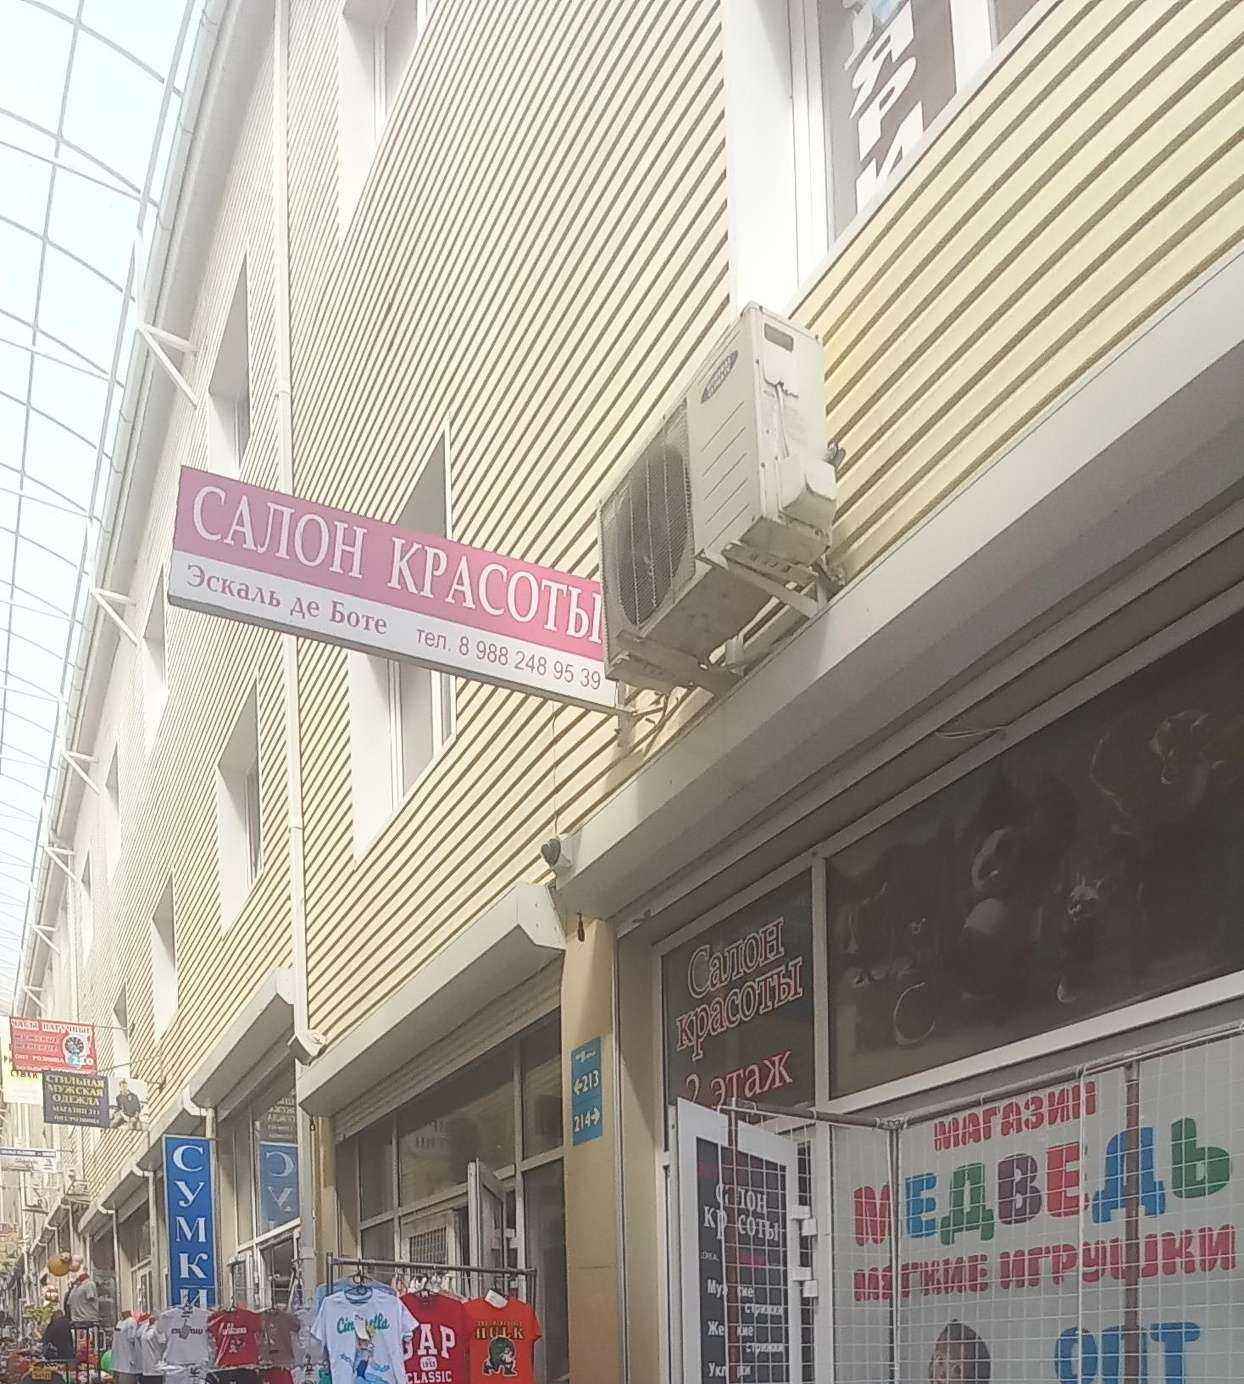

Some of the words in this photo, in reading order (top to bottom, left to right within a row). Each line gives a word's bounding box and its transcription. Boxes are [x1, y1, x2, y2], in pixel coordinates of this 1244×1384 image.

[186, 563, 281, 608] Эскаль
[290, 592, 320, 619] де
[330, 602, 388, 635] Боте
[192, 485, 367, 579] САЛОН
[387, 536, 603, 645] КРАСОТЫ
[416, 627, 452, 654] тел.
[458, 637, 471, 657] 8
[476, 641, 509, 666] 988
[514, 649, 548, 677] 248
[553, 658, 575, 684] 95
[579, 666, 602, 691] 39
[687, 916, 785, 999] Салон
[675, 956, 803, 1063] красоты
[582, 1069, 599, 1093] 213
[710, 1051, 794, 1114] этаж
[933, 1080, 1097, 1152] МАГАЗИН
[574, 1111, 591, 1133] 214
[852, 1117, 1233, 1247] МЕДВЕДЬ
[172, 1144, 210, 1309] СУМКИ
[703, 1206, 780, 1241] крсоты
[999, 1224, 1237, 1293] ИГРУШКИ
[406, 1370, 453, 1384] CLASSIC
